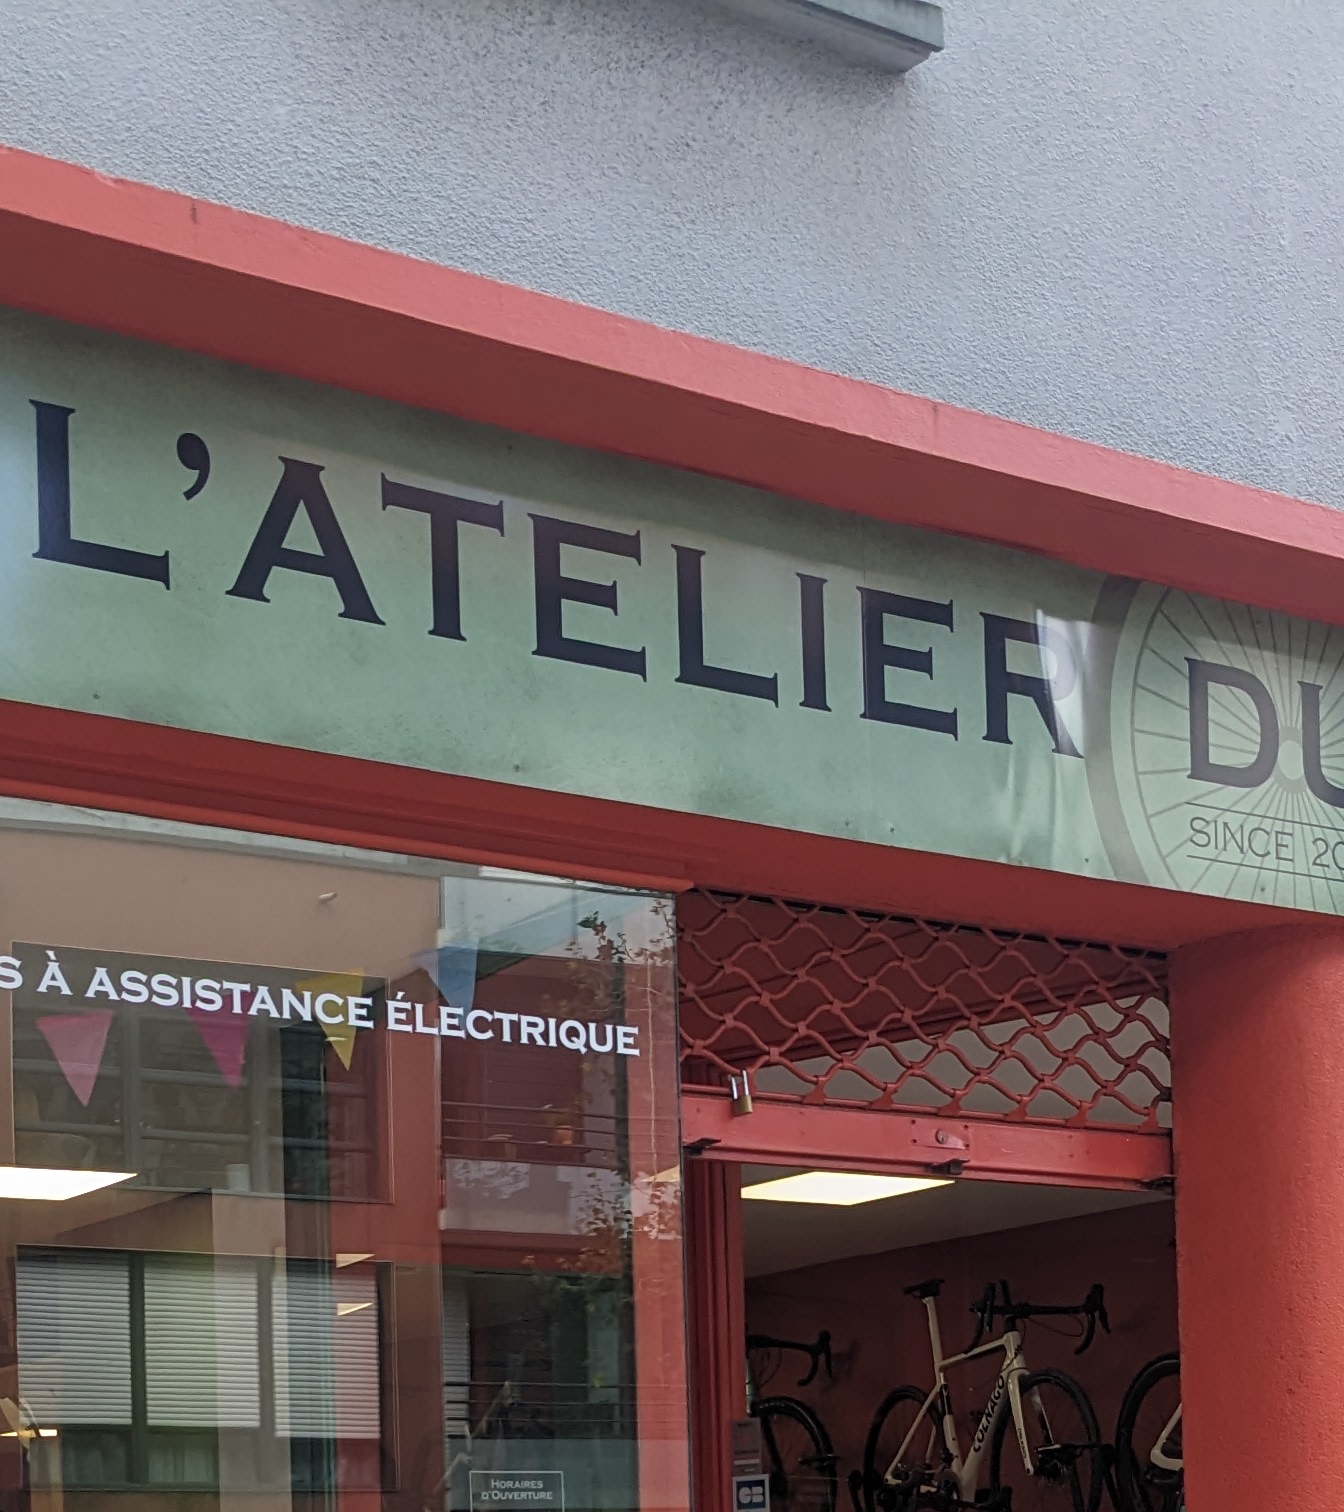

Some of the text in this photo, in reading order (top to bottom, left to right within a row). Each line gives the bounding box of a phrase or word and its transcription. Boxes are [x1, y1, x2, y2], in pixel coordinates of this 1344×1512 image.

[29, 399, 1083, 759] L'ATELIER
[1187, 814, 1296, 864] SINCE
[36, 950, 74, 996] À
[84, 966, 375, 1031] ASSISTANCE
[385, 990, 641, 1059] ÉLECTRIQUE
[973, 1374, 1005, 1453] COLNAGO
